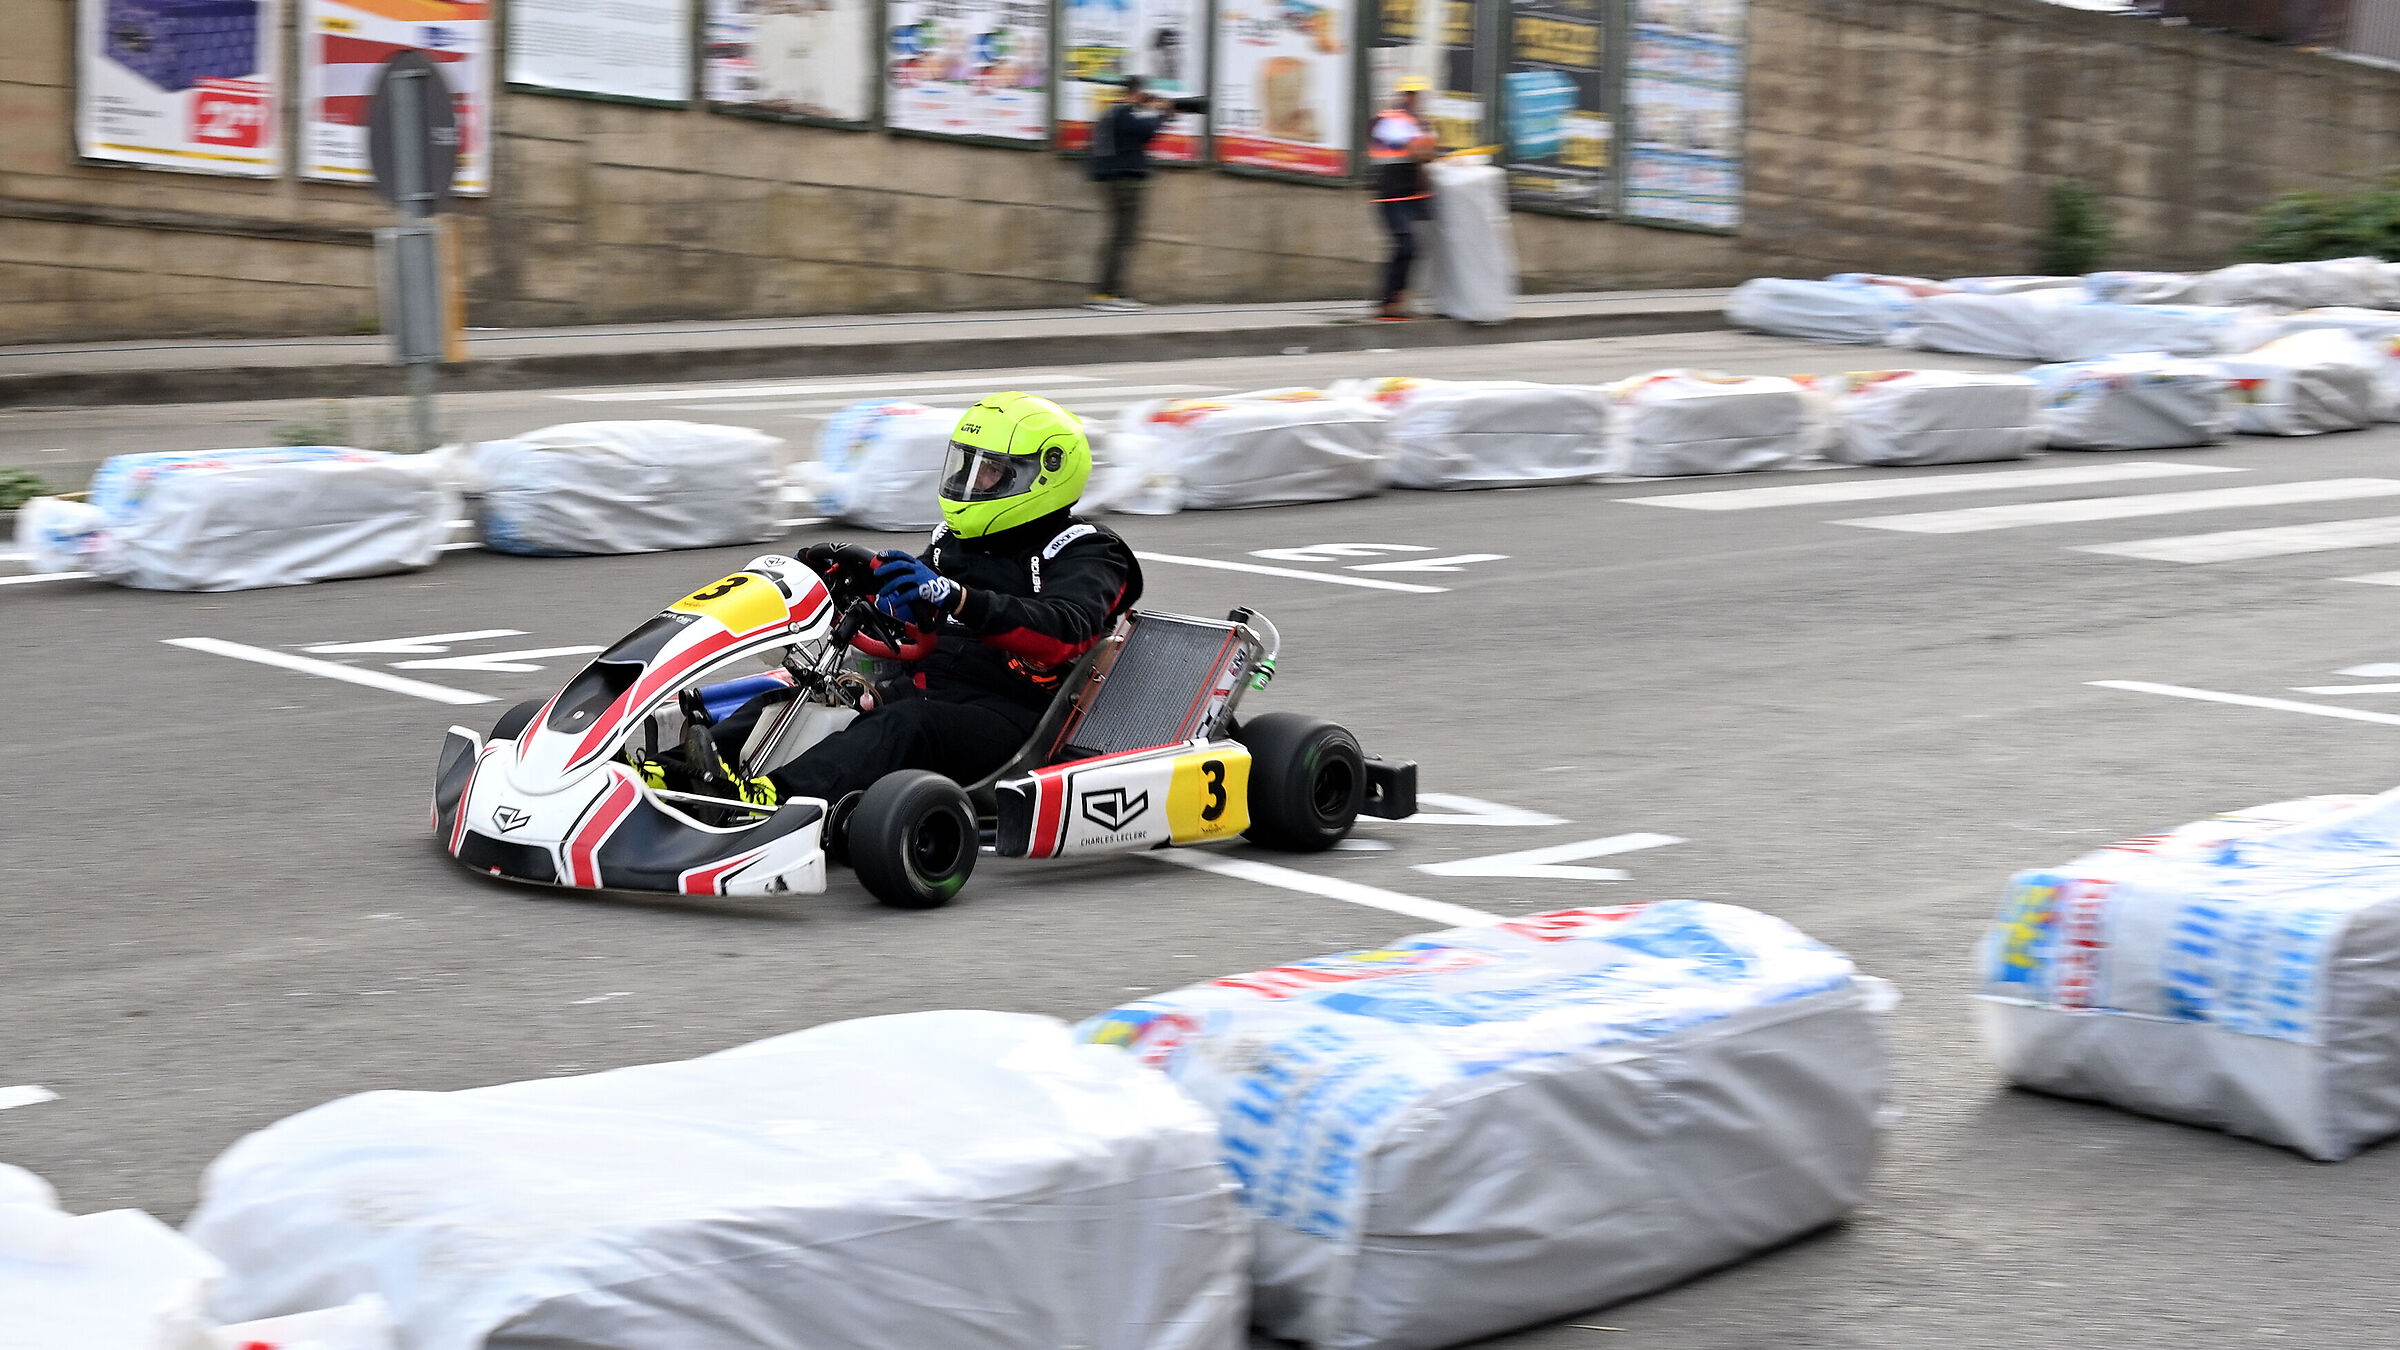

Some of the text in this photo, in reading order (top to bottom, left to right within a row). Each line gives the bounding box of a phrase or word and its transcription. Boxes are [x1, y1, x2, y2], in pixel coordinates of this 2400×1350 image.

[961, 423, 982, 434] GIVI
[693, 576, 749, 601] 3
[1201, 760, 1227, 821] 3
[1080, 830, 1148, 846] CHARLES LECLERC
